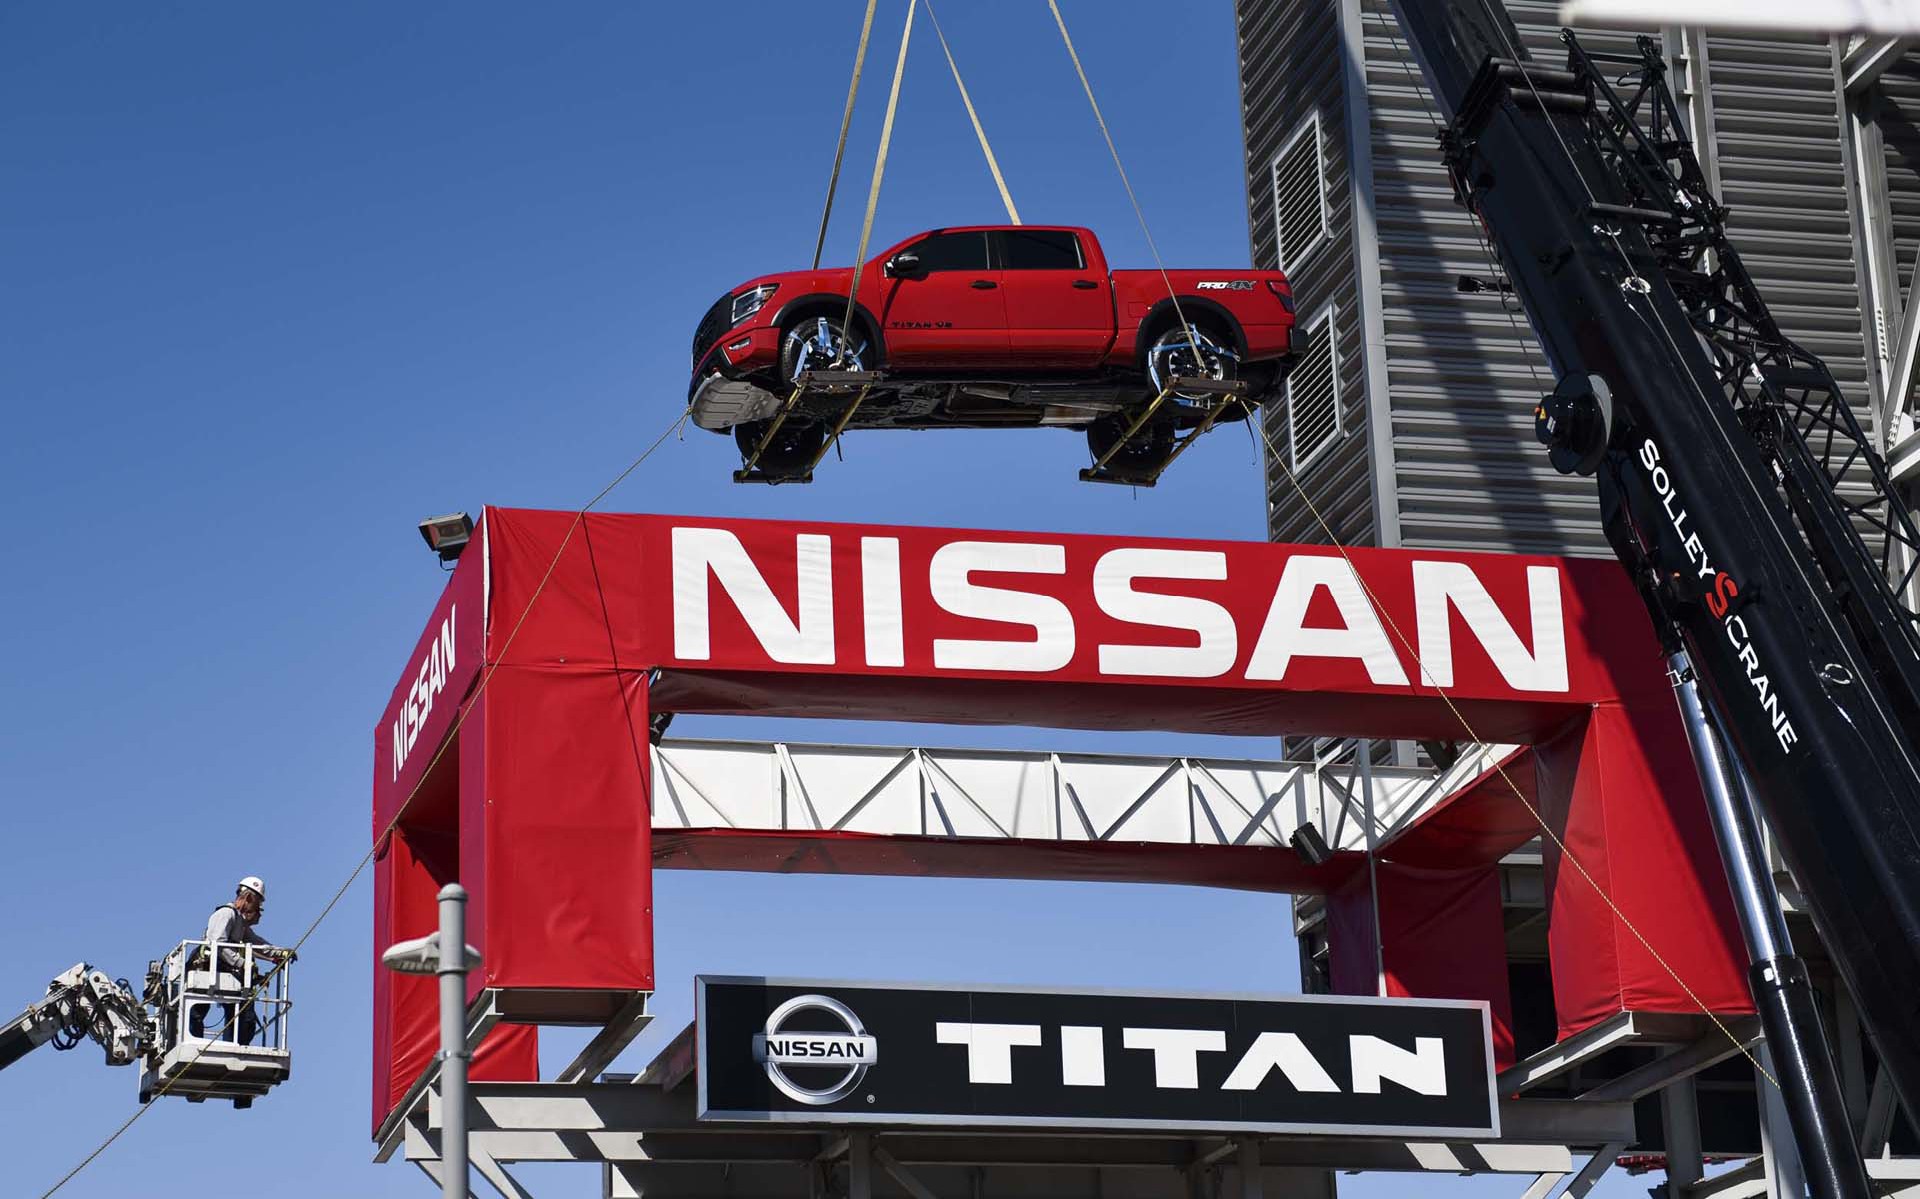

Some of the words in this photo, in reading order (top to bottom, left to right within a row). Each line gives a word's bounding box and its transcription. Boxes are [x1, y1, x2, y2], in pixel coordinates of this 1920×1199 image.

[672, 527, 1569, 692] NISSAN
[1639, 438, 1716, 580] SOLLEY
[1725, 614, 1799, 754] CRANE
[393, 603, 456, 783] NISSAN
[766, 1040, 864, 1058] NISSAN
[936, 1022, 1447, 1096] TITAN
